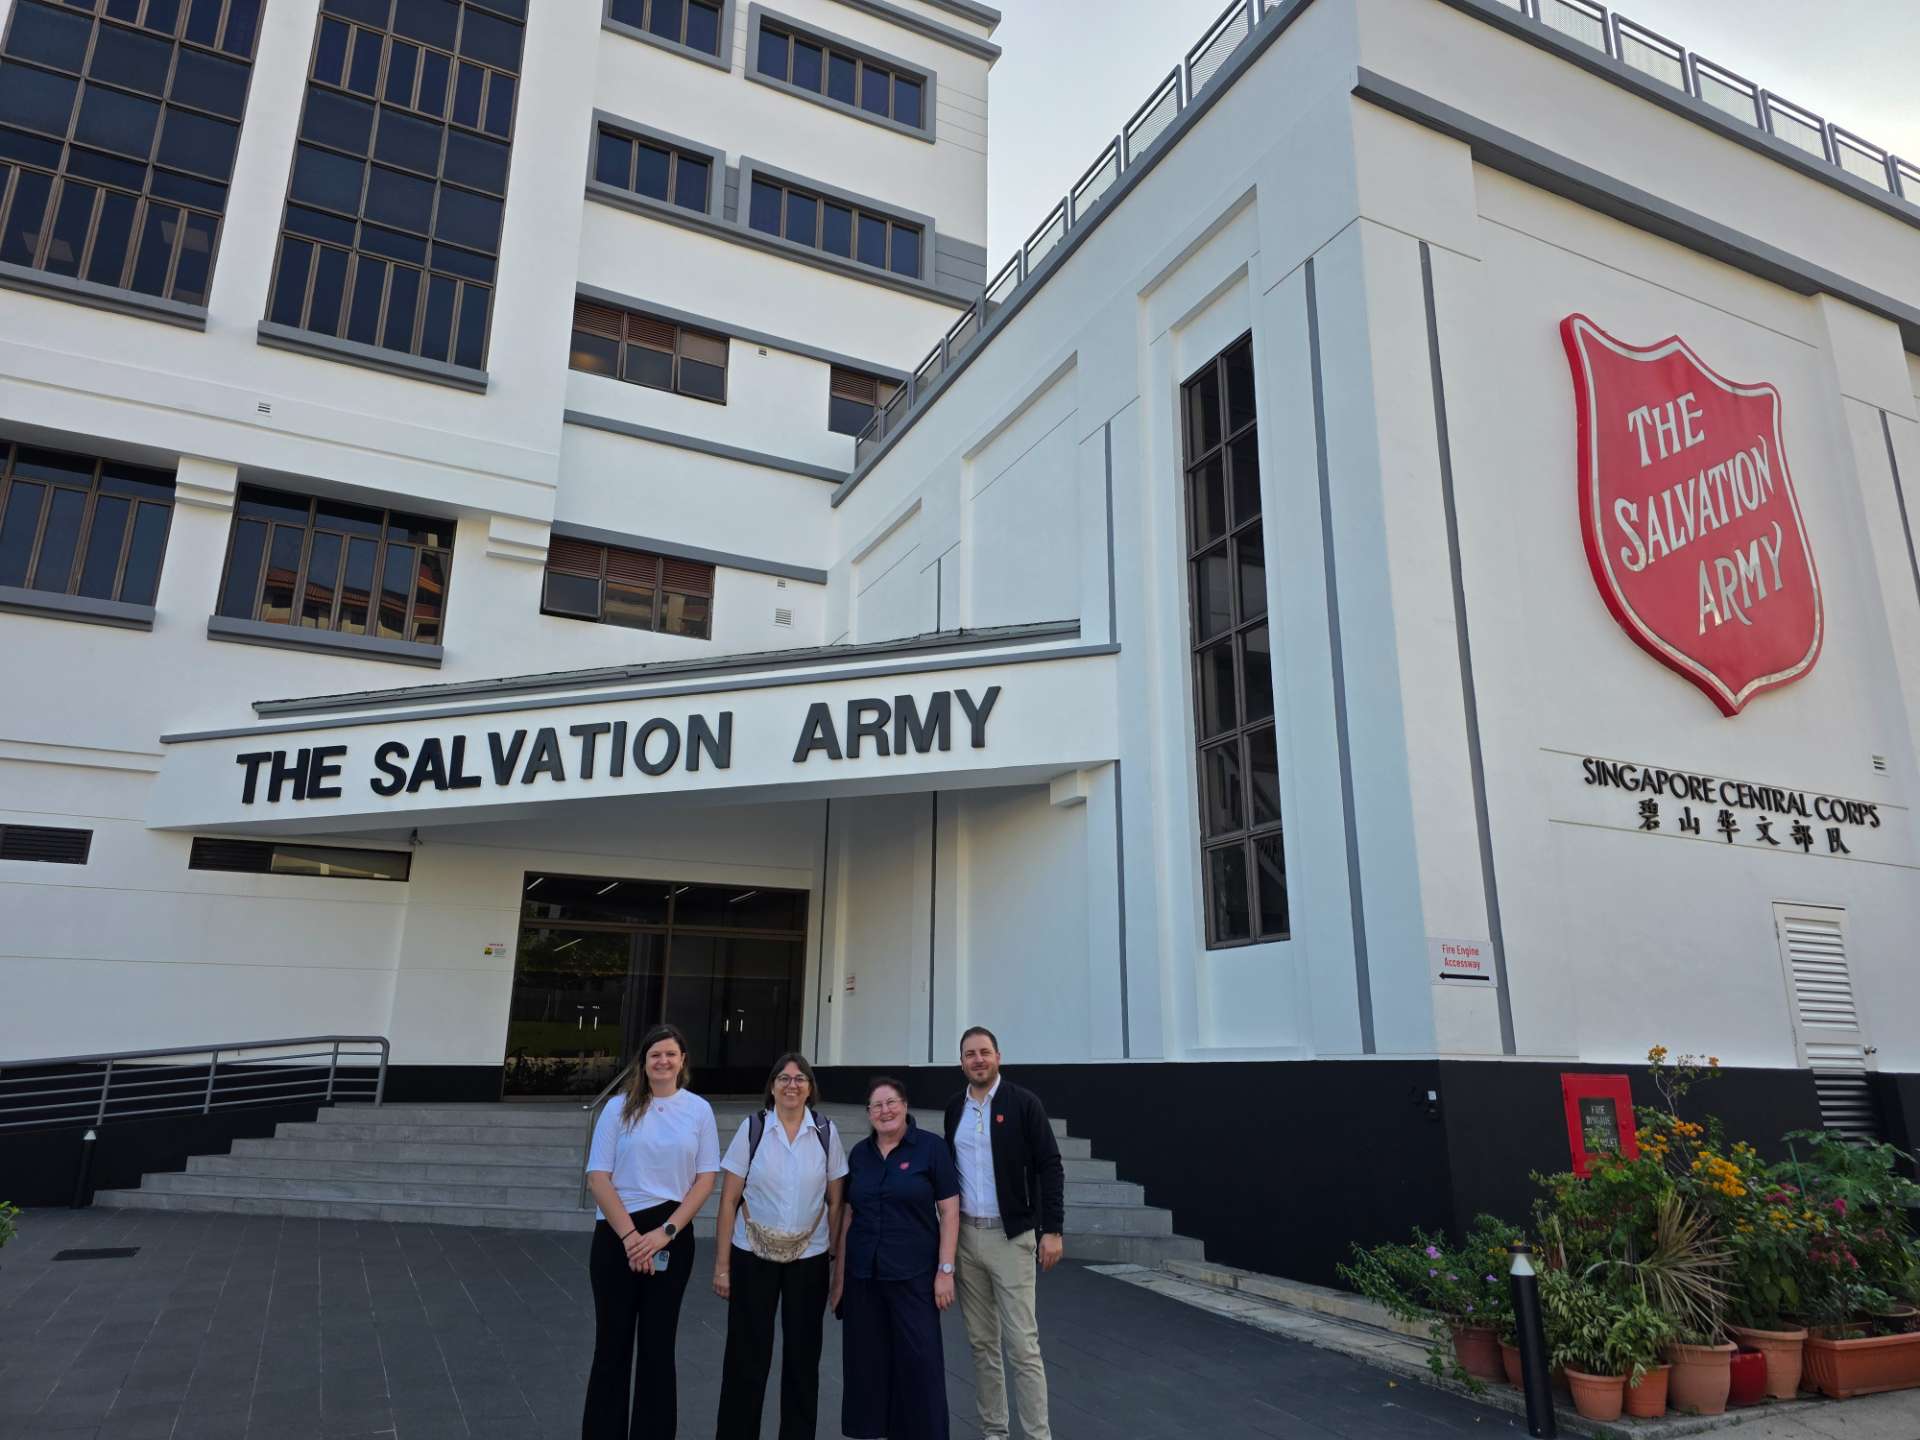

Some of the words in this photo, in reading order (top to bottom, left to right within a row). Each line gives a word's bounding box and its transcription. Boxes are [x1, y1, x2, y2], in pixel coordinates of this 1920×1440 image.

[1627, 392, 1705, 468] THE
[1614, 434, 1775, 573] SALVATION
[1698, 520, 1783, 636] ARMY
[236, 744, 348, 804] THE
[369, 710, 734, 797] SALVATION
[792, 685, 1002, 764] ARMY
[1582, 757, 1718, 804] SINGAPORE
[1719, 780, 1813, 818] CENTRAL
[1814, 796, 1881, 828] CORPS
[1638, 797, 1851, 854] 碧山华文部队
[1441, 943, 1456, 954] Fire
[1456, 944, 1480, 957] Engine
[1444, 956, 1481, 971] Accessway
